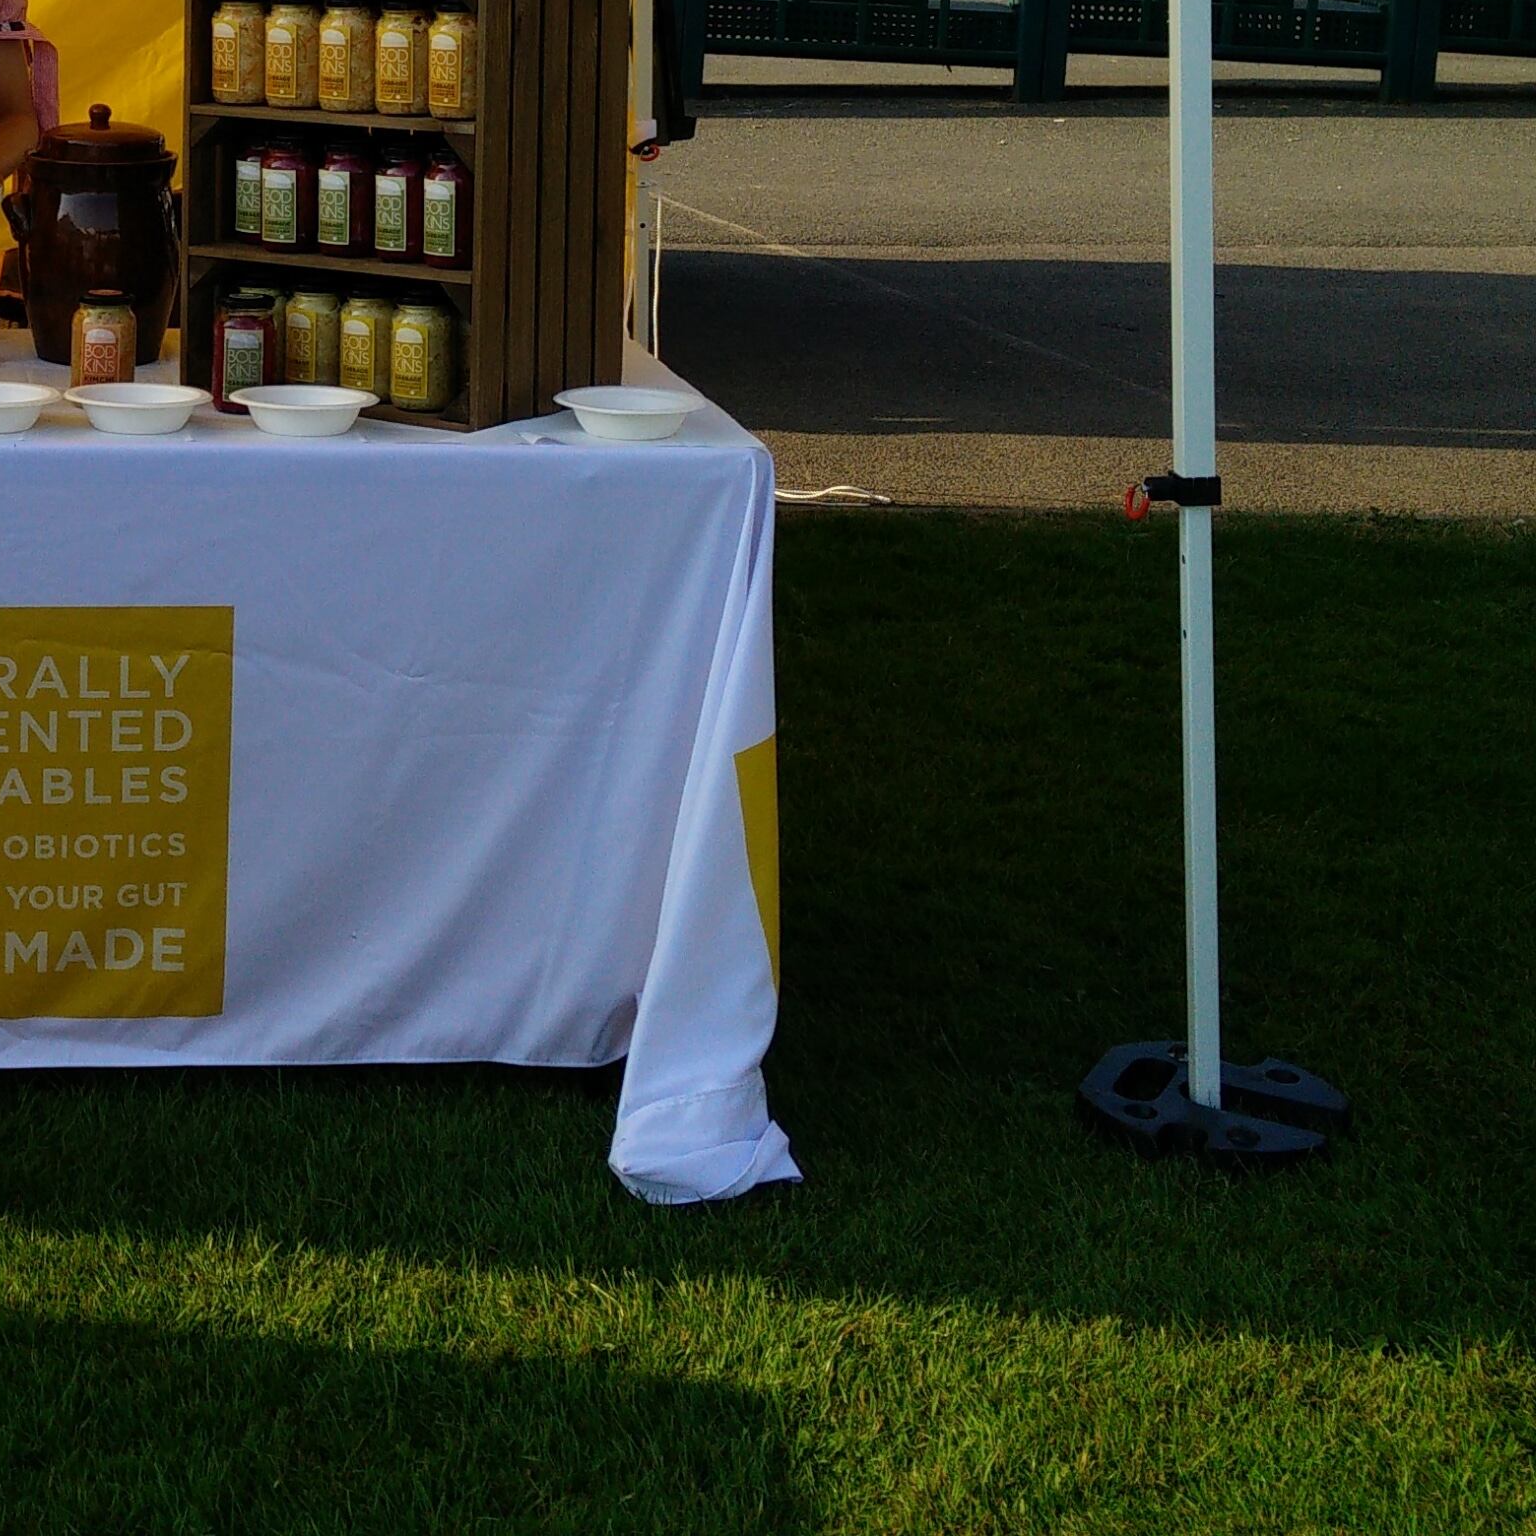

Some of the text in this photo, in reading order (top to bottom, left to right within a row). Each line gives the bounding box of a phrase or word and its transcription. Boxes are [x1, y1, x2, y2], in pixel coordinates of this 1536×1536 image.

[84, 344, 115, 359] BOD
[228, 350, 259, 364] BOD
[6, 884, 104, 912] YOUR
[116, 881, 188, 909] GUT
[4, 927, 187, 975] MADE
